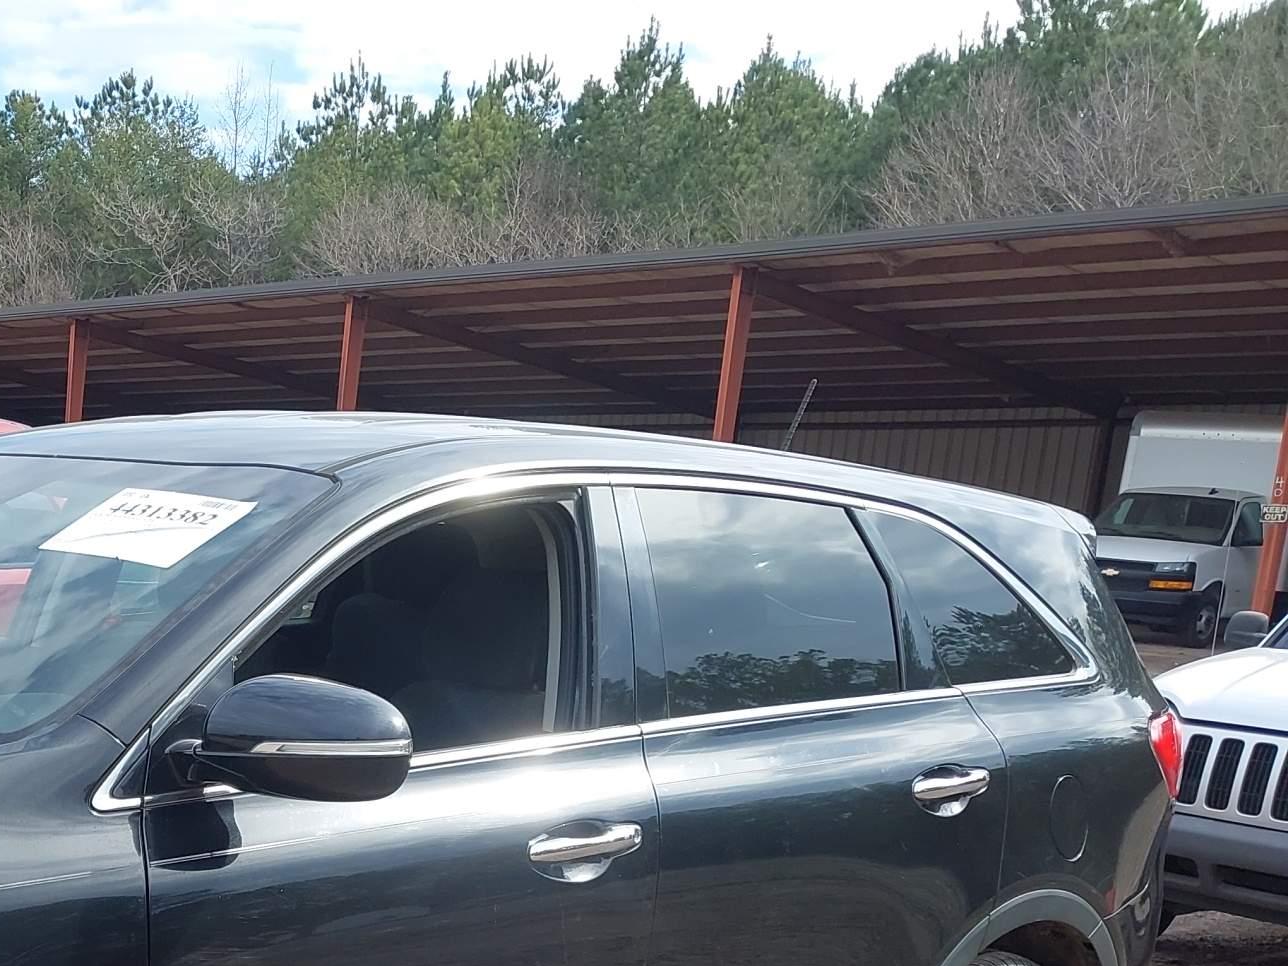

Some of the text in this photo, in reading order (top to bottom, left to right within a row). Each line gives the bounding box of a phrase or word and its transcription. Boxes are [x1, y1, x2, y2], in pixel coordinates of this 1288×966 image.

[109, 501, 219, 526] 44313382
[1262, 506, 1288, 514] KEEP
[1263, 513, 1285, 521] OUT
